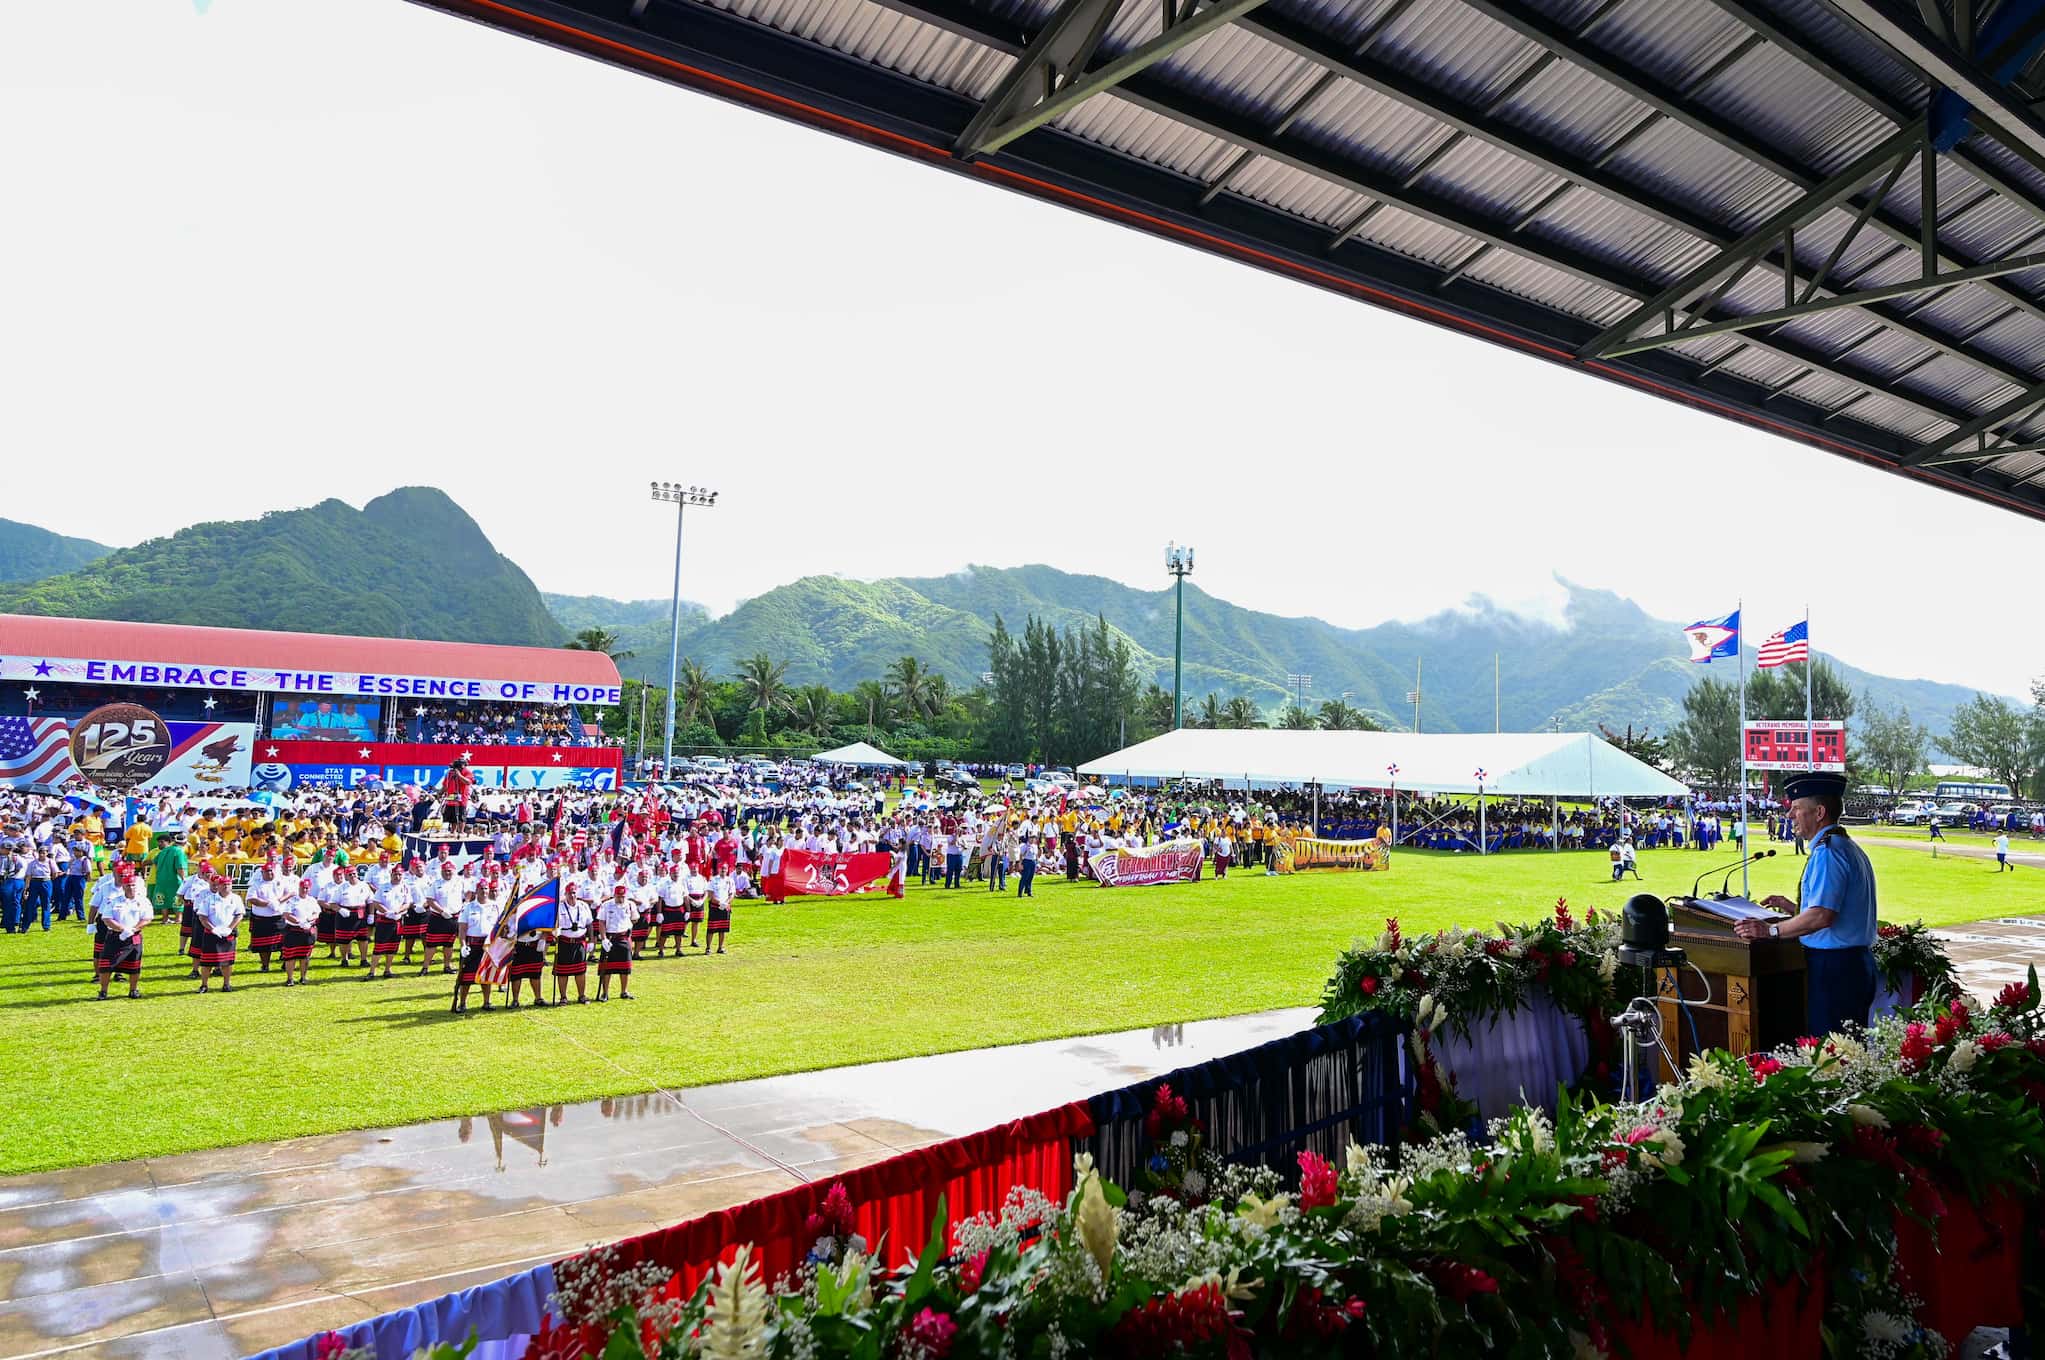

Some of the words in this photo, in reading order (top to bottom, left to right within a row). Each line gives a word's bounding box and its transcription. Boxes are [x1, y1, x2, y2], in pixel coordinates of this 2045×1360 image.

[86, 661, 248, 687] EMBRACE
[274, 672, 334, 691] THE
[358, 675, 481, 699] ESSENCE
[500, 682, 536, 699] OF
[553, 684, 621, 703] HOPE
[80, 720, 157, 764] 125
[124, 752, 162, 766] Years
